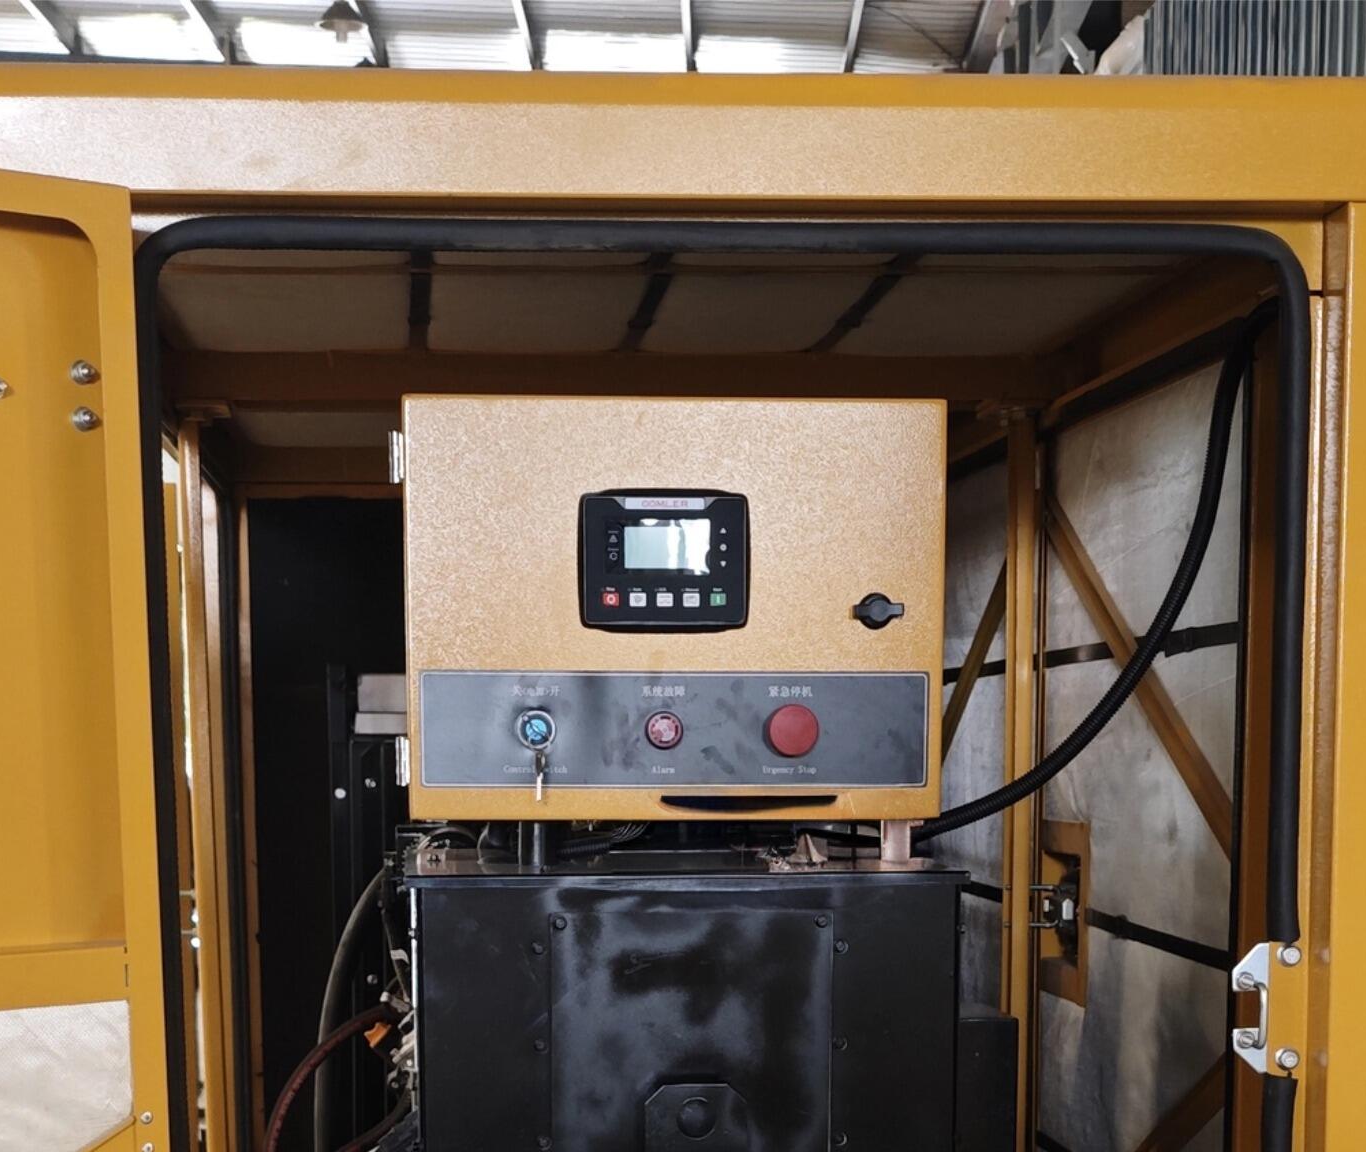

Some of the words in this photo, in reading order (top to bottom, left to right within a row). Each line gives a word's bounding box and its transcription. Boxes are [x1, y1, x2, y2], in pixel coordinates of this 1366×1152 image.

[768, 685, 813, 697] 紧急停机
[651, 765, 676, 774] Alarm
[798, 765, 817, 775] Stop
